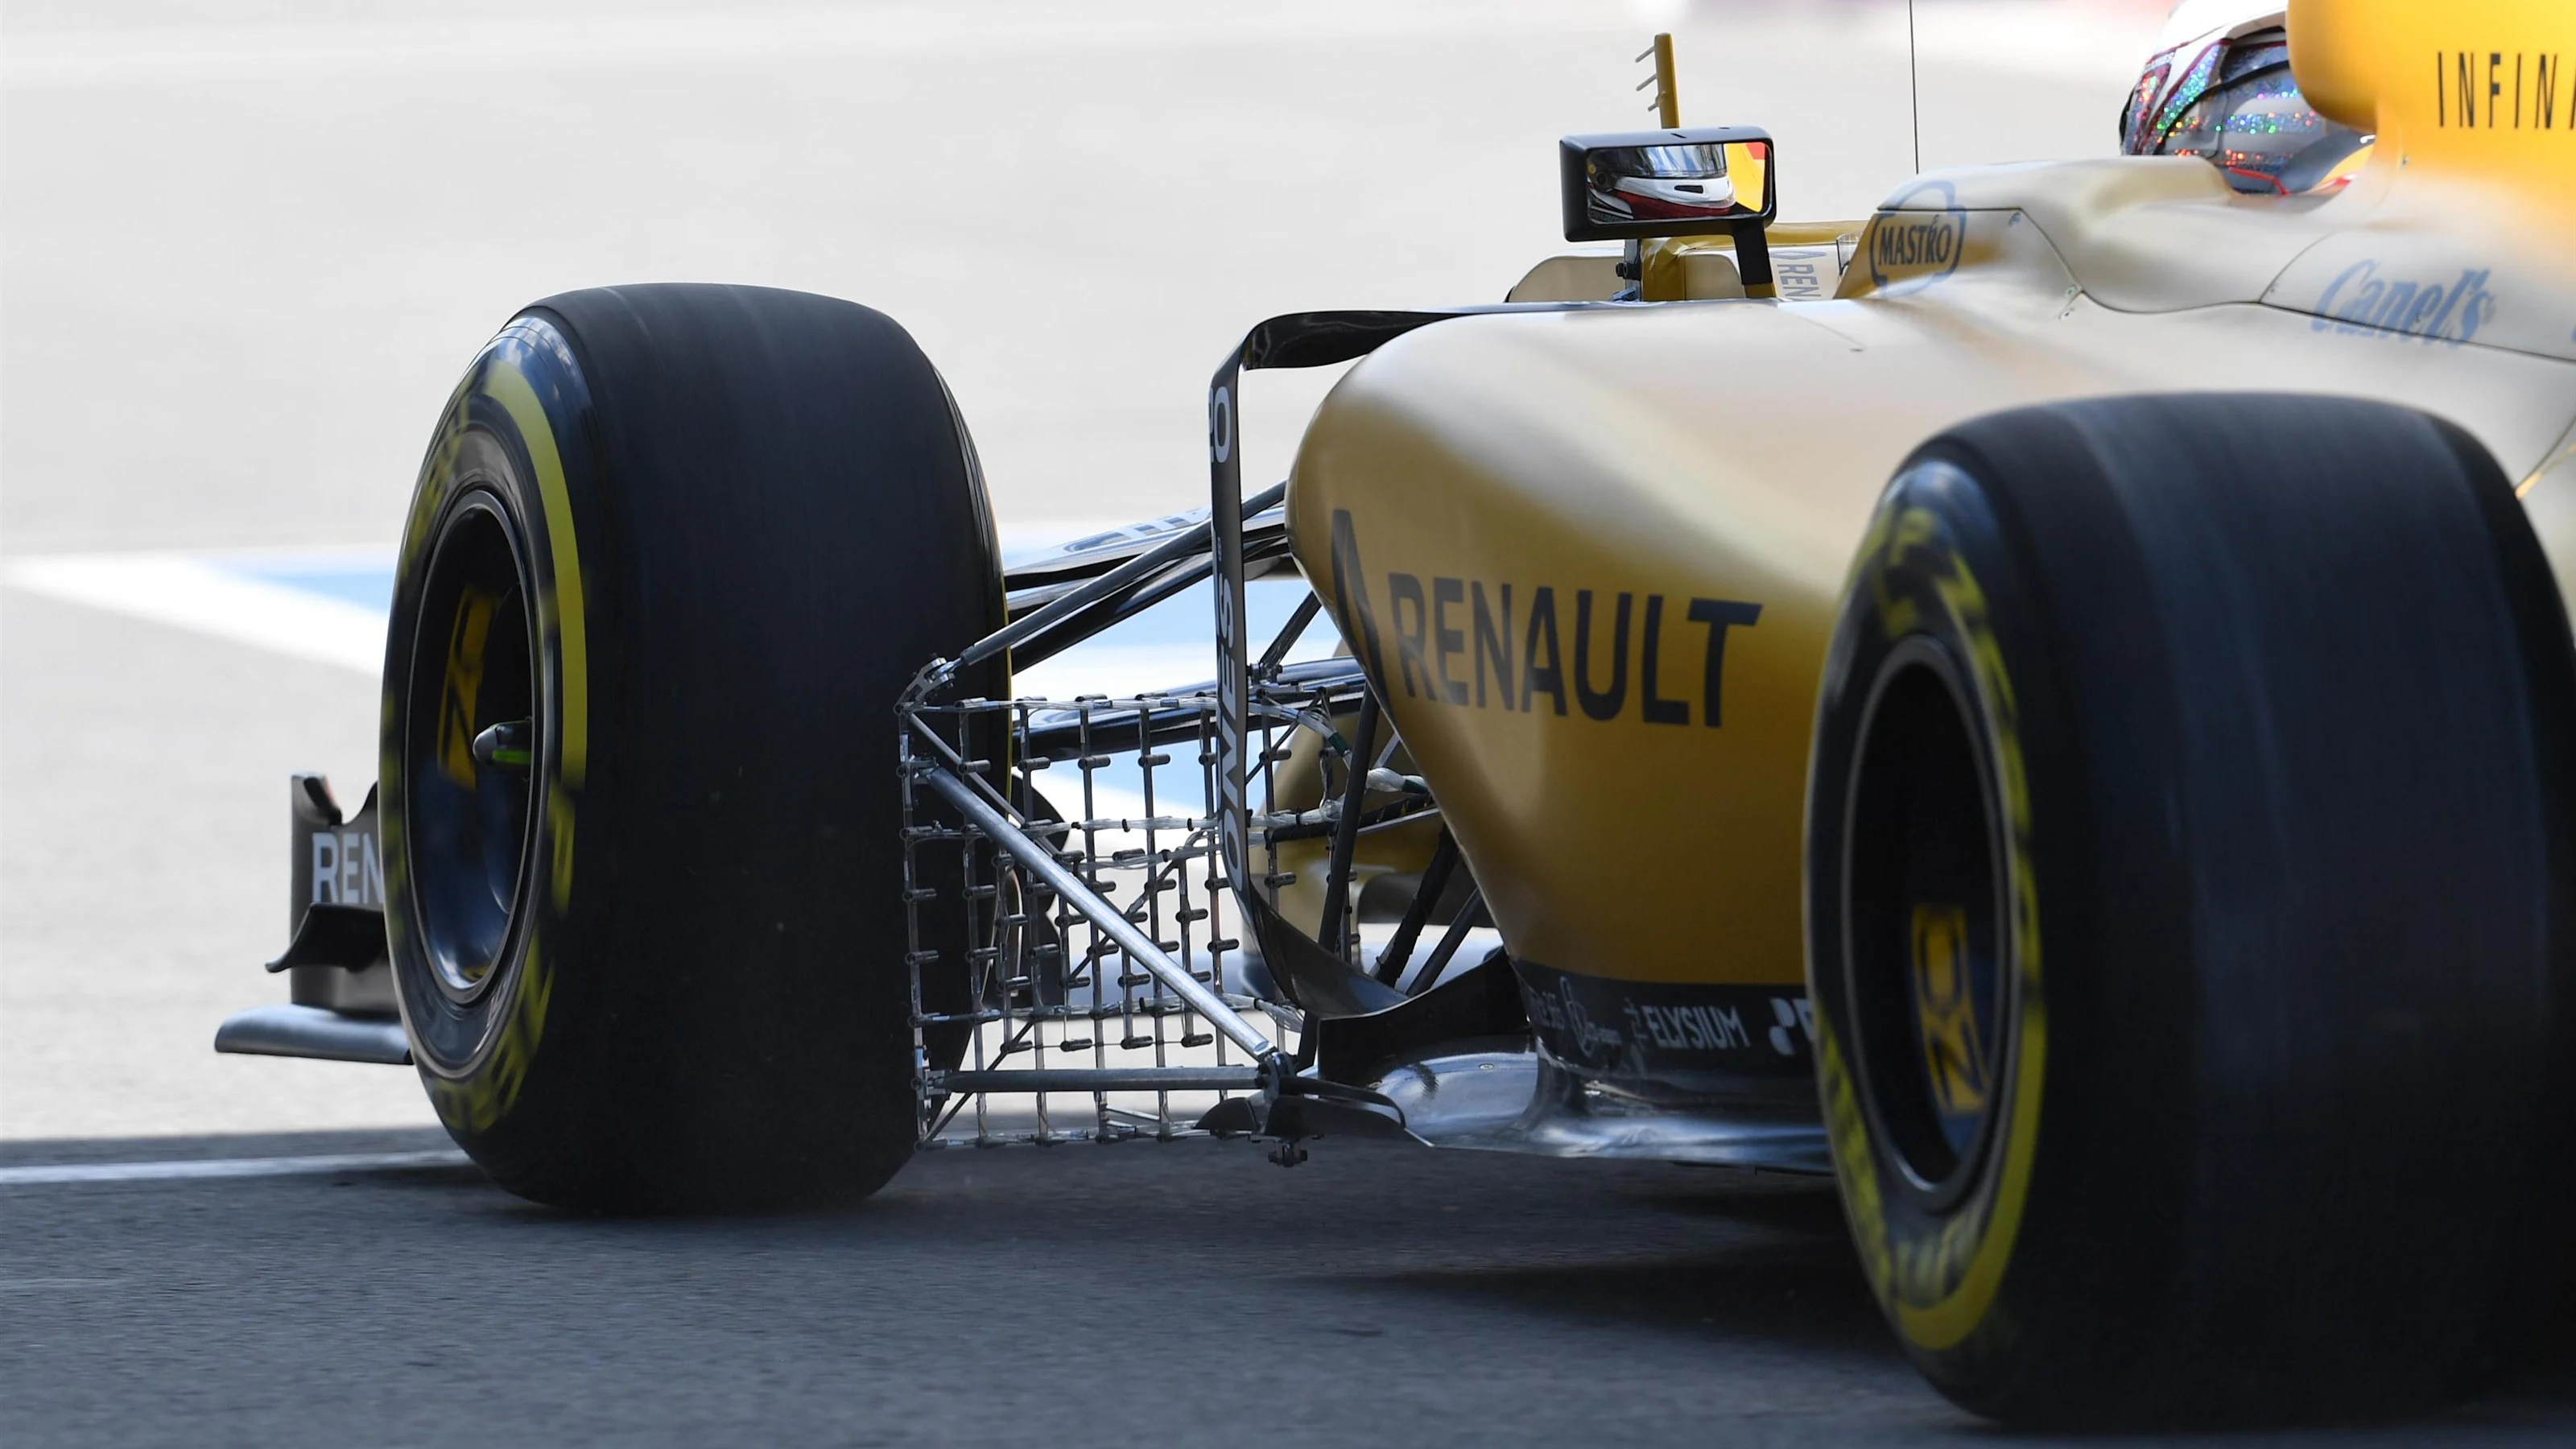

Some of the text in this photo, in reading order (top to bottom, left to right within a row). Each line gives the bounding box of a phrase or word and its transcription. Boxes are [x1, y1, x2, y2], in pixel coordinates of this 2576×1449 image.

[1777, 264, 1822, 299] REN
[1389, 572, 1762, 728] RENAULT
[1218, 573, 1242, 894] ONES
[312, 832, 384, 904] REN
[1641, 1005, 1751, 1050] ELYSIUM
